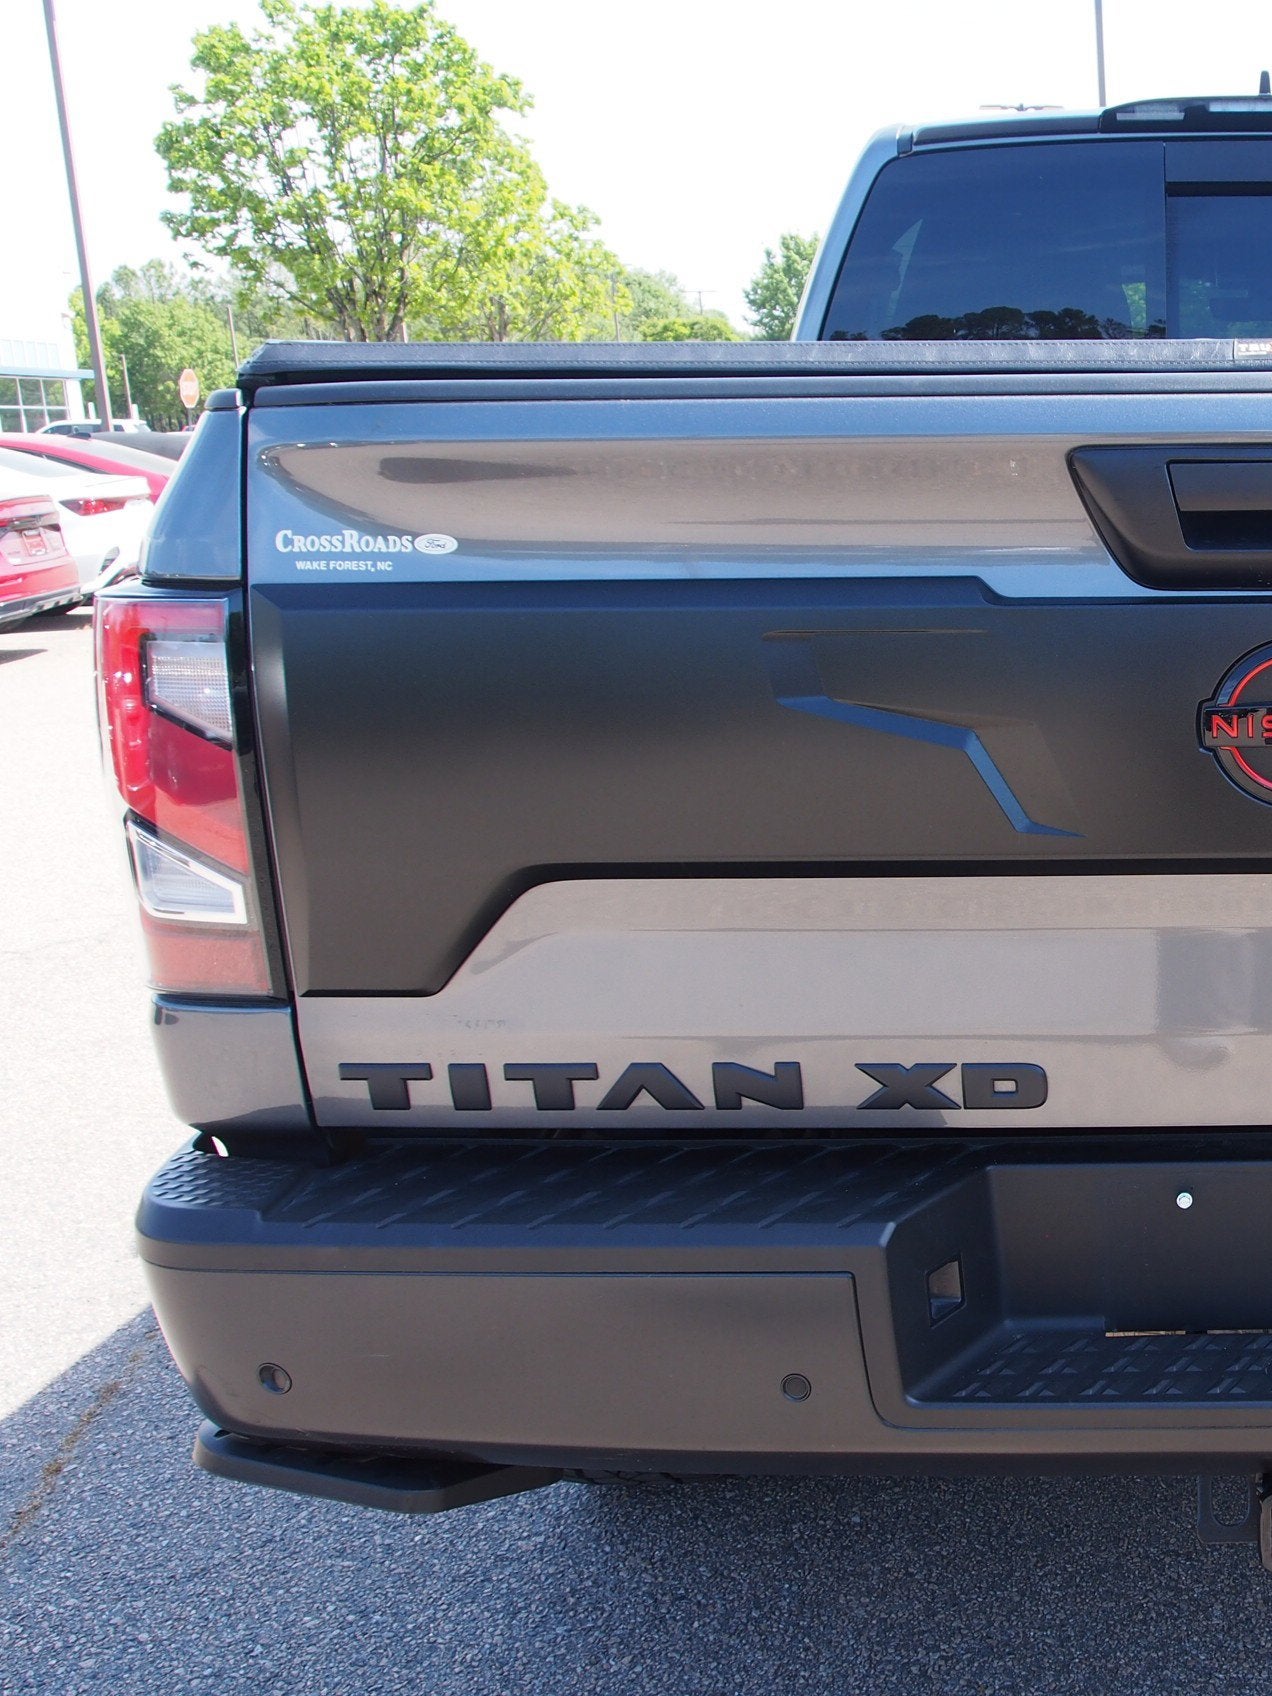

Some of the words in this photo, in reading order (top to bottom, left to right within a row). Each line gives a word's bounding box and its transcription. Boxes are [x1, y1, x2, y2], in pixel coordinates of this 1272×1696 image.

[295, 561, 327, 571] WAKE
[329, 561, 374, 572] FOREST,
[377, 561, 393, 571] NC
[338, 1061, 804, 1111] TITAN
[854, 1062, 1049, 1110] XD
